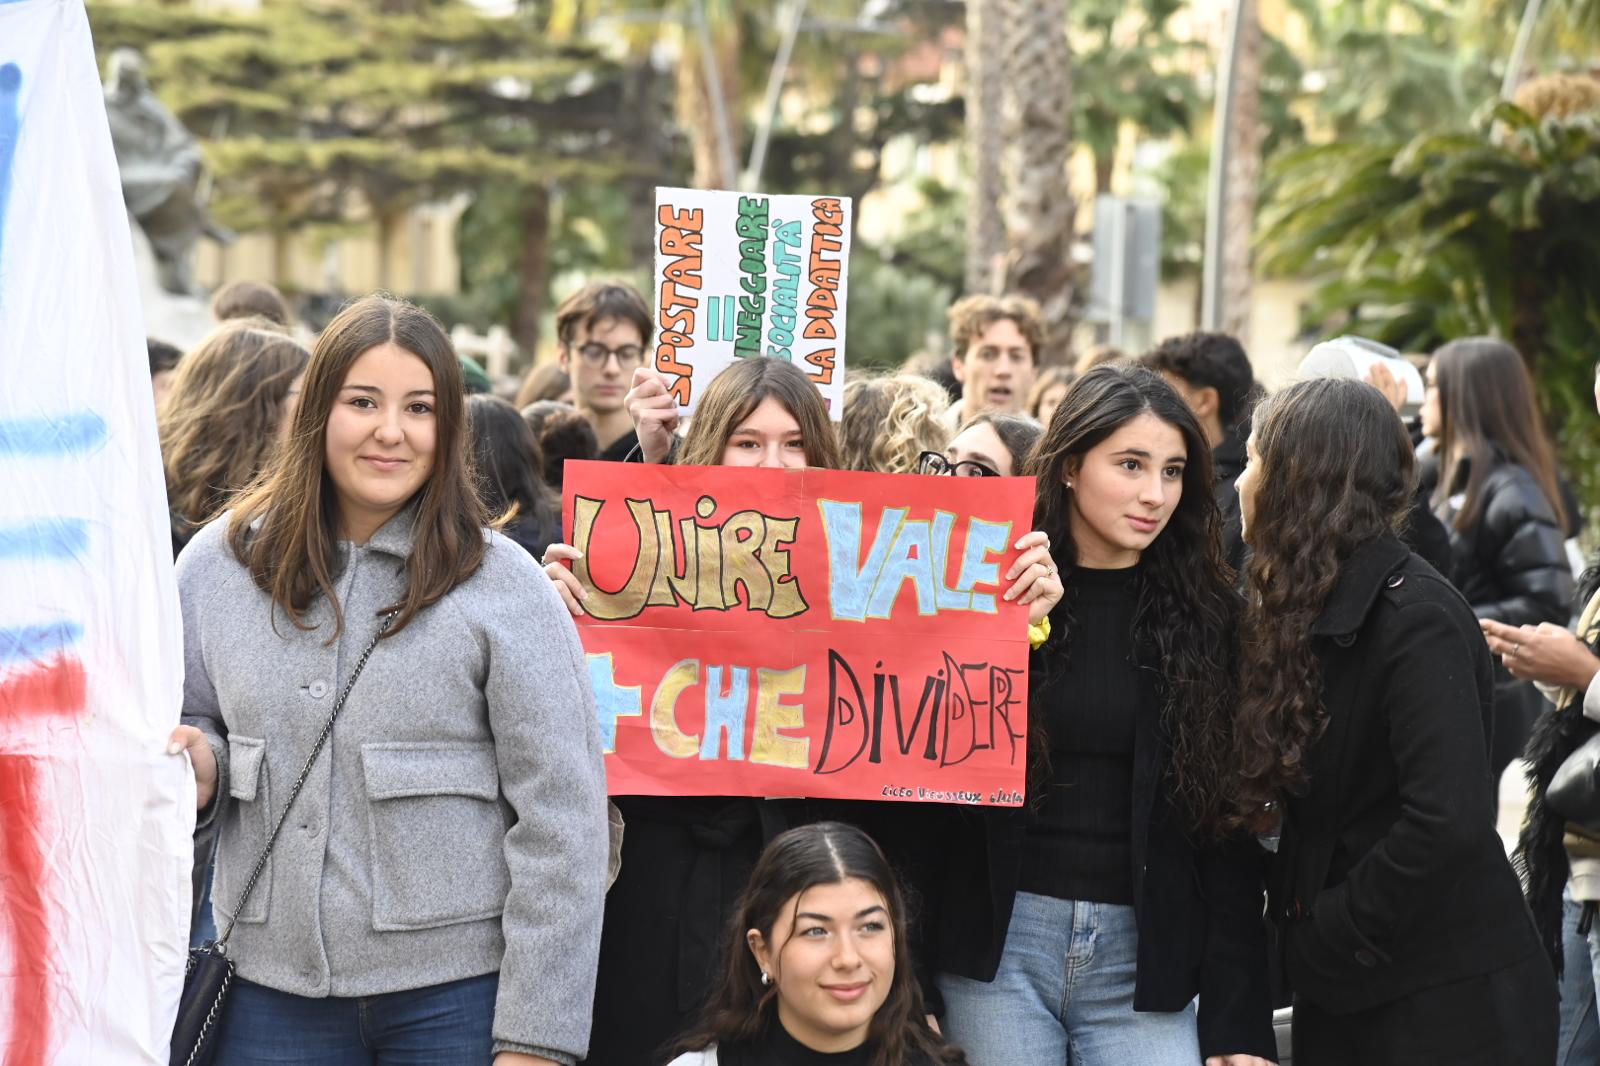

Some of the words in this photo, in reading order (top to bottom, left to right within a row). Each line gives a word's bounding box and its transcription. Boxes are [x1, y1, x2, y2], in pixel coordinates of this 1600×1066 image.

[656, 204, 704, 406] SPOSTARE
[803, 197, 844, 340] DIDATTICA
[804, 347, 836, 385] LA
[816, 497, 1013, 622] VALE
[649, 658, 810, 769] CHE
